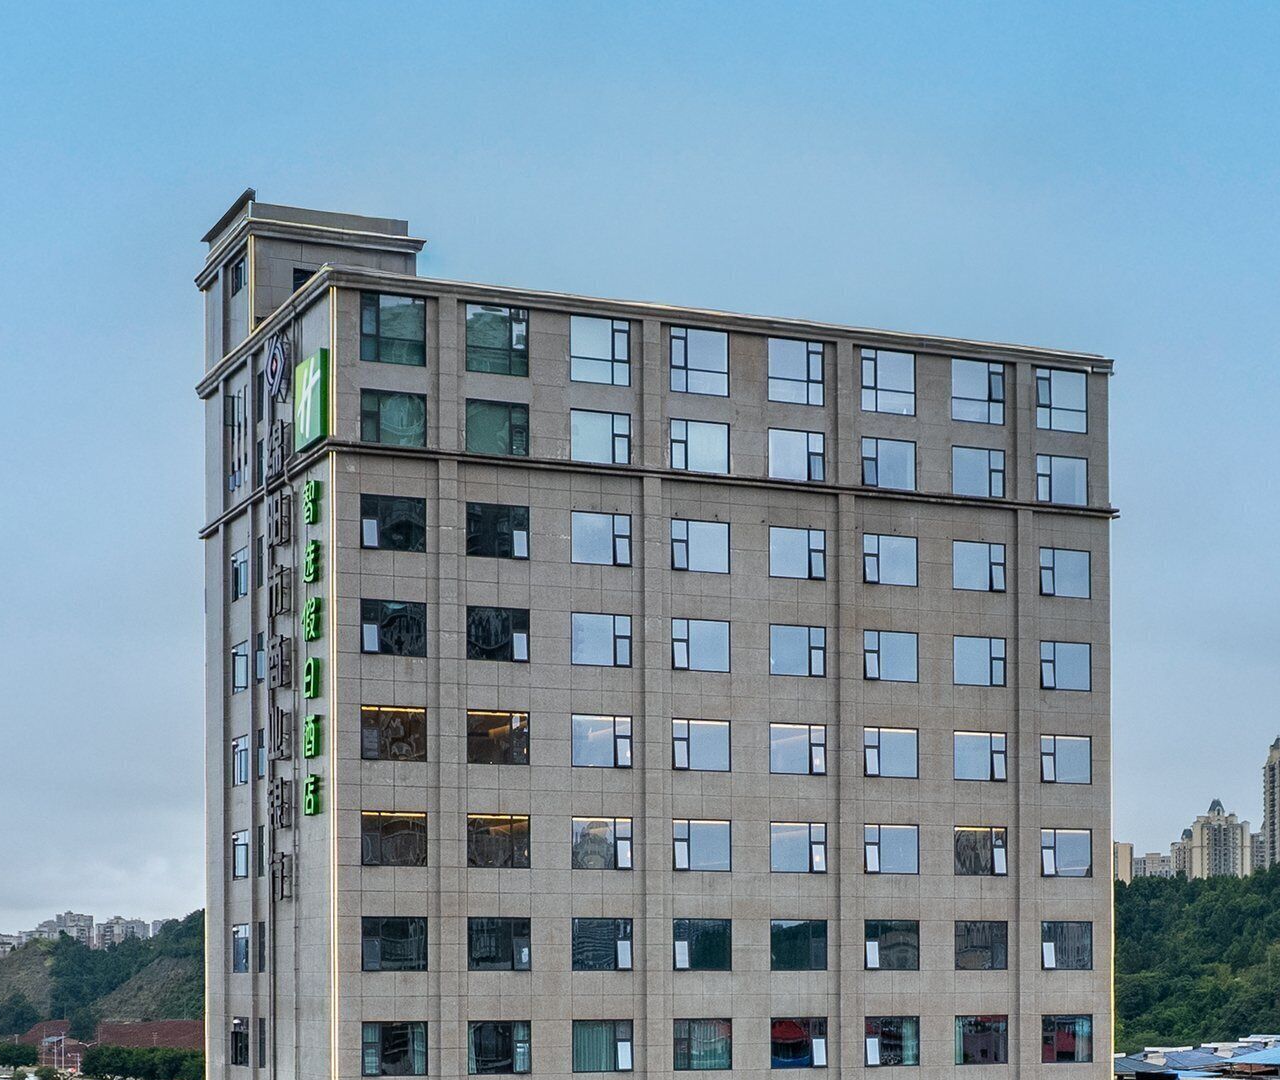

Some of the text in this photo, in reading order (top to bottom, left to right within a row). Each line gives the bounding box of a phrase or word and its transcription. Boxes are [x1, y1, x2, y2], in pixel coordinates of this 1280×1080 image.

[301, 479, 321, 816] 智选假日酒店
